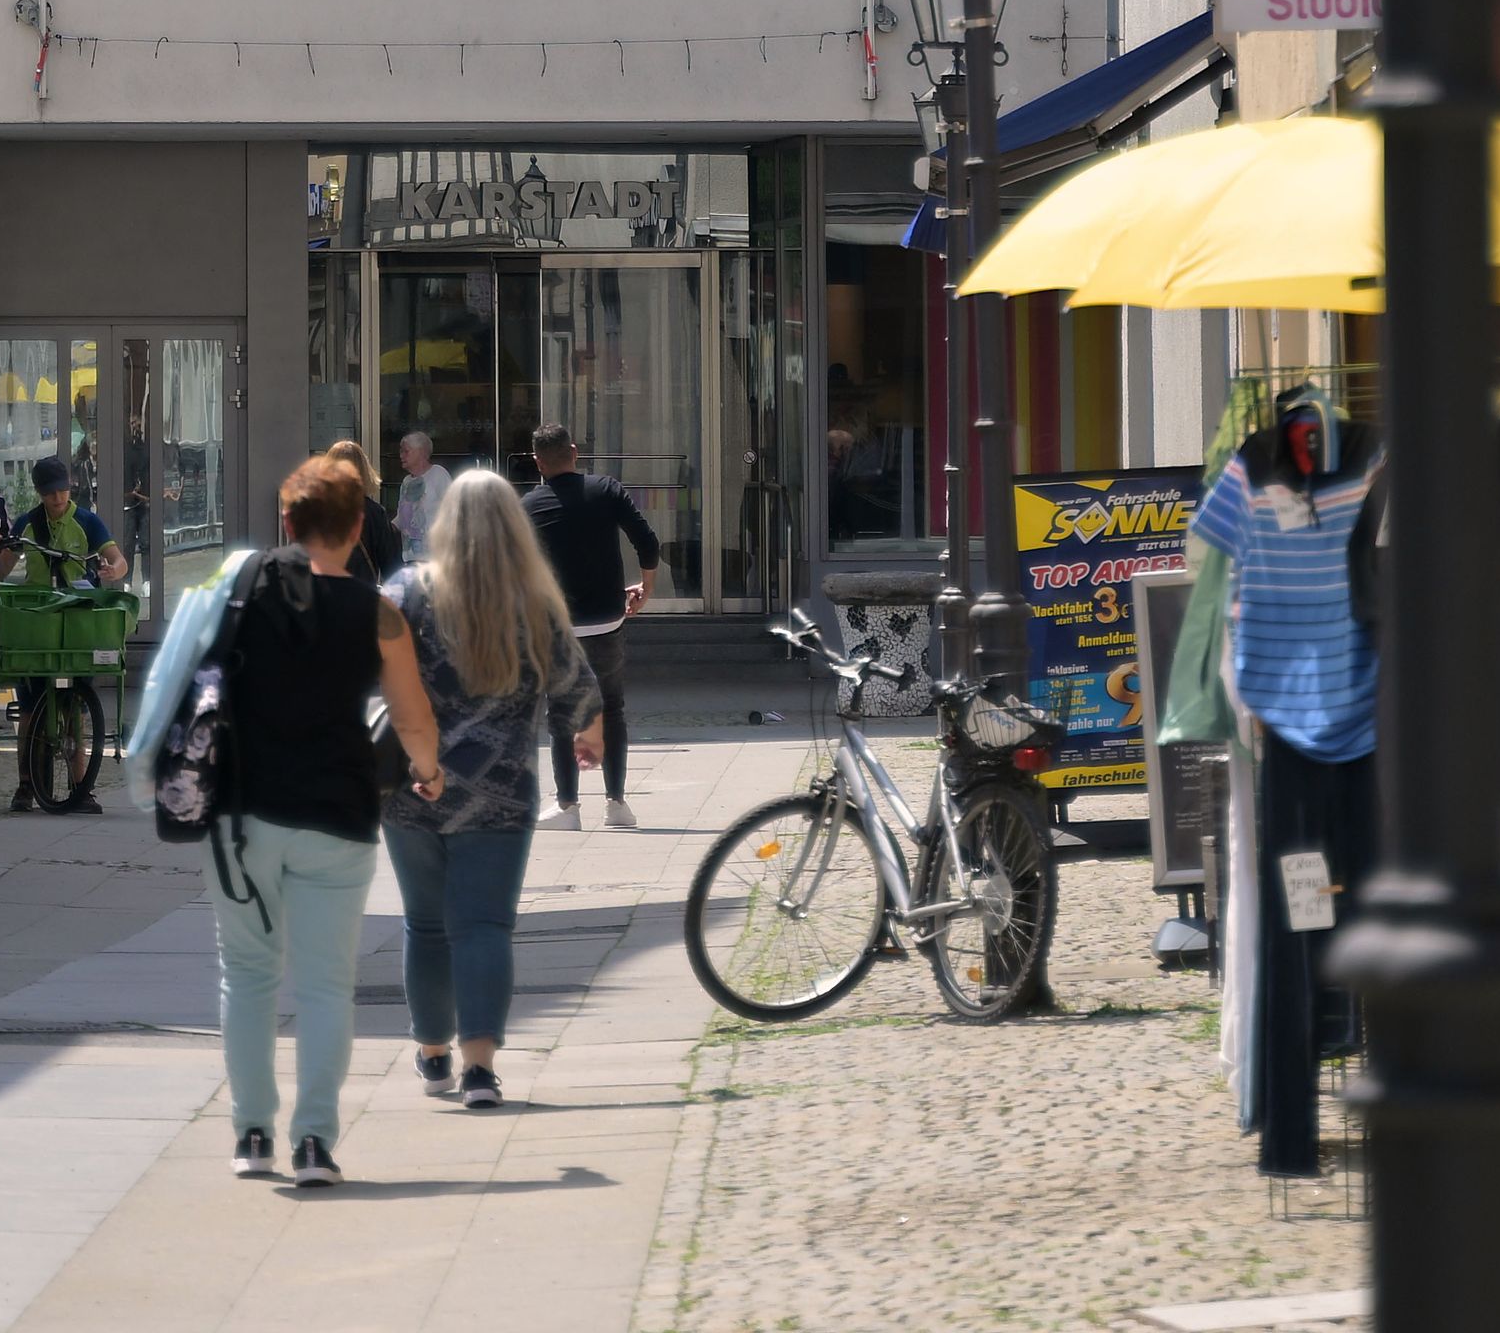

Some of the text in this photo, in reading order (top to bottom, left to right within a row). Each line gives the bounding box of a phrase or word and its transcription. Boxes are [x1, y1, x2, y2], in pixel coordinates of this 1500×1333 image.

[400, 180, 681, 220] KARSTADT
[1106, 488, 1182, 507] Fahrschule
[1030, 563, 1090, 590] TOP
[1032, 601, 1093, 618] Nachtfahrt
[1094, 587, 1120, 624] 3
[1056, 617, 1073, 626] statt
[1096, 718, 1115, 728] nur
[1062, 767, 1145, 787] fahrschule
